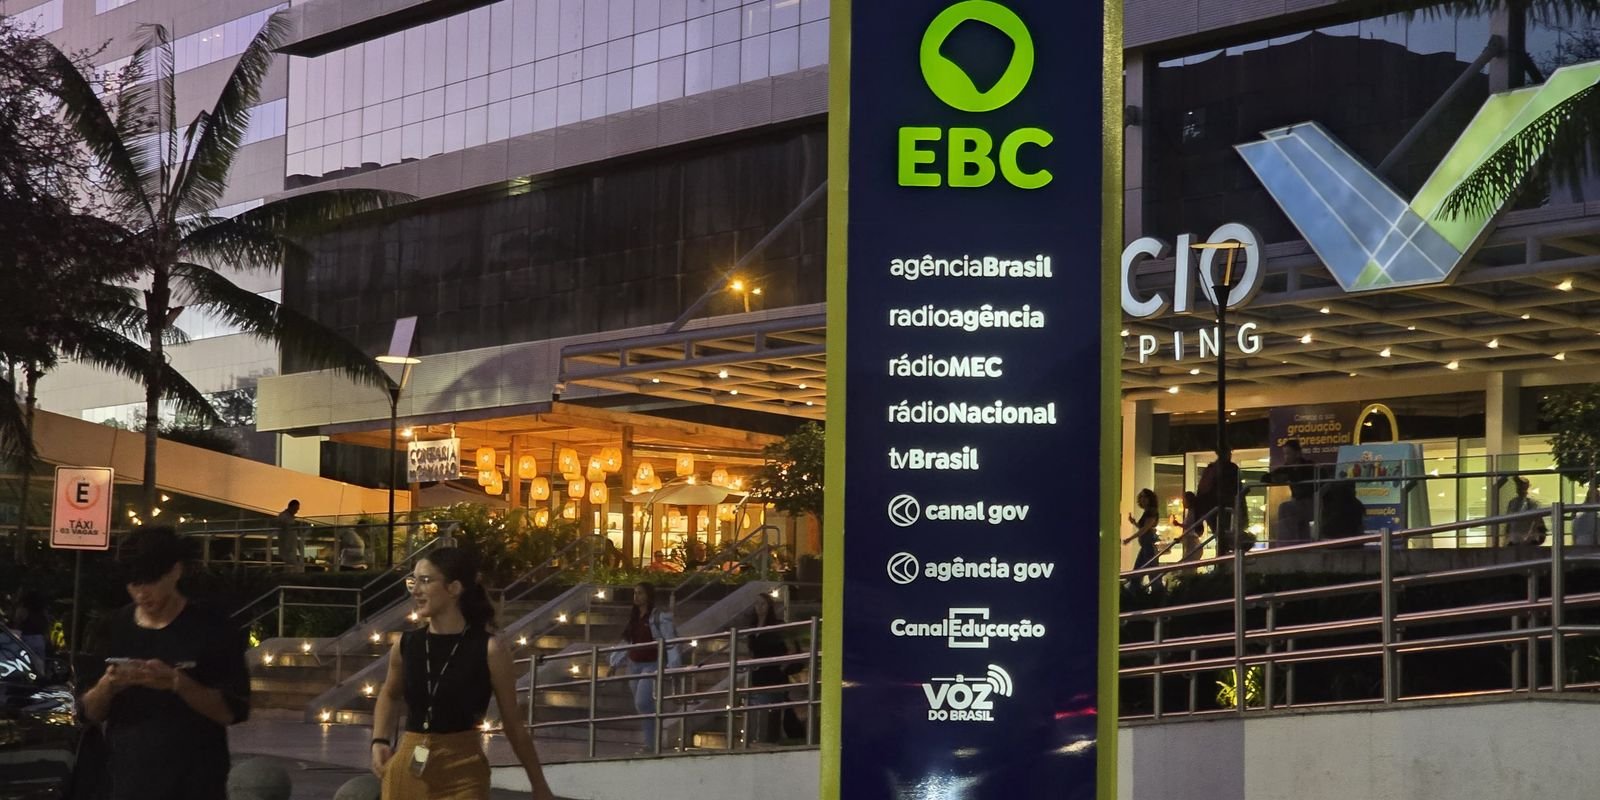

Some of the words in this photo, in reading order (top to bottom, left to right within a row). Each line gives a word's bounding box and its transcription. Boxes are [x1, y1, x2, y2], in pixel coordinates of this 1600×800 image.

[898, 126, 1054, 190] EBC
[890, 254, 1053, 281] agênciaBrasil
[889, 304, 1045, 331] radioagência
[888, 353, 1003, 378] rádioMEC
[888, 399, 1057, 425] rádioNacional
[1276, 431, 1351, 447] seipresencial
[1287, 420, 1342, 436] graduação
[888, 446, 979, 470] tvBrasil
[76, 482, 90, 503] E
[925, 501, 985, 521] canal
[988, 504, 1029, 525] gov
[924, 557, 1010, 582] agência
[1013, 562, 1055, 583] gov
[890, 618, 1046, 642] CanalEducação
[922, 683, 994, 710] VOZ
[928, 710, 948, 721] DO
[949, 710, 994, 722] BRASIL
